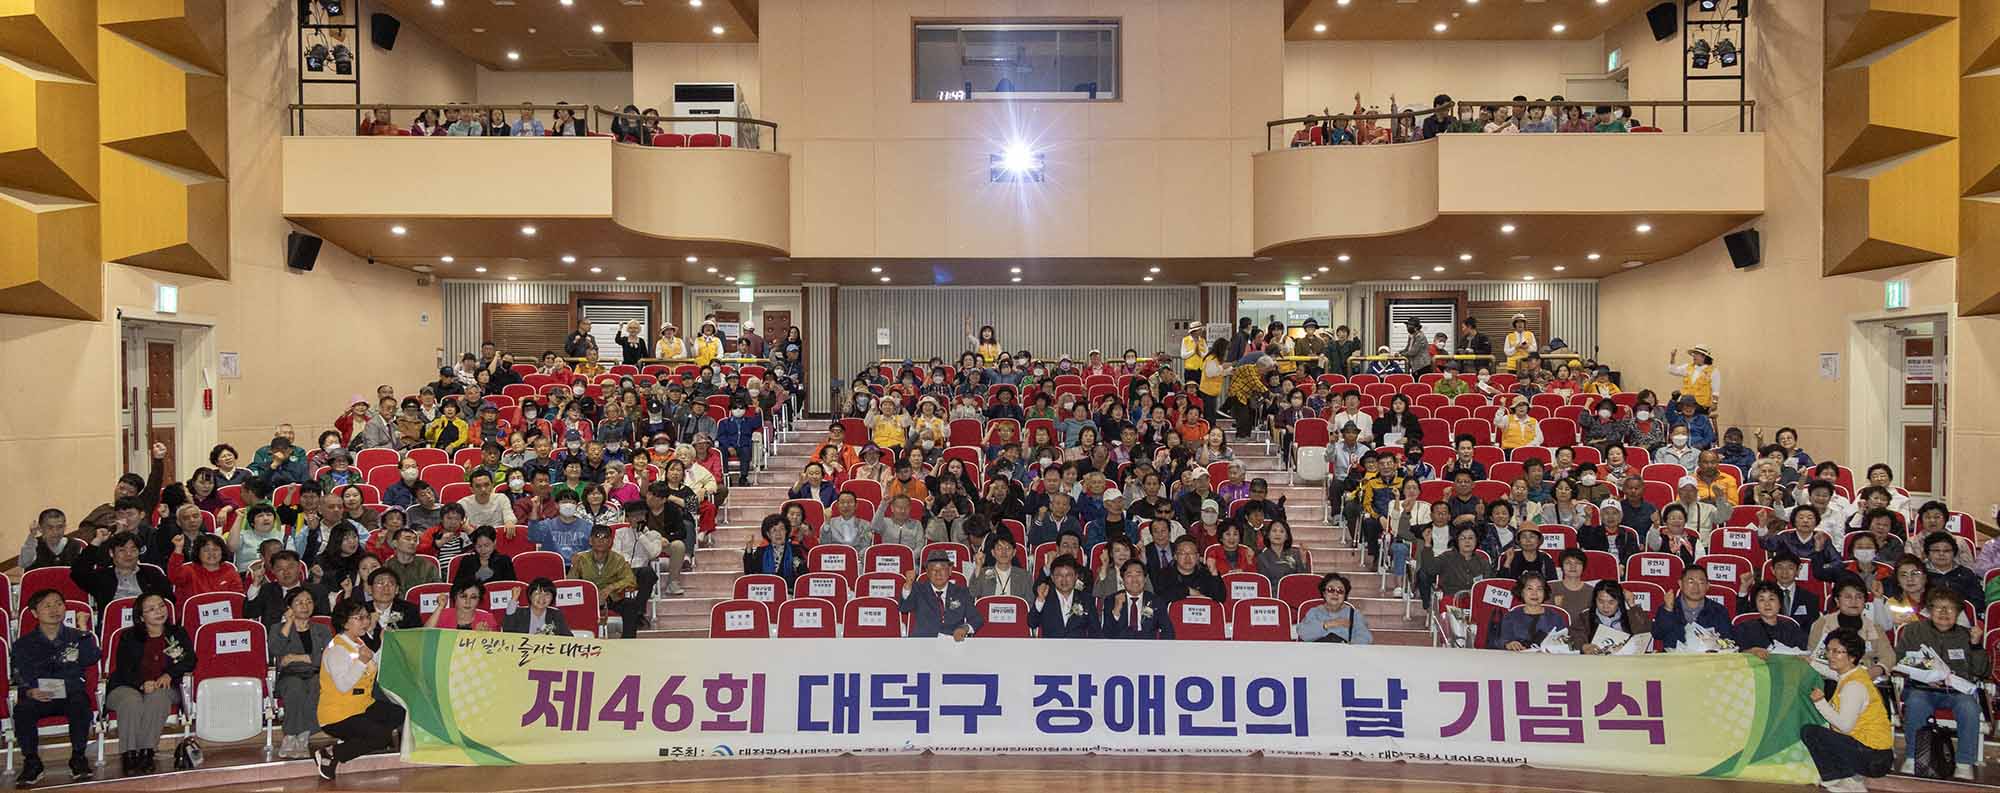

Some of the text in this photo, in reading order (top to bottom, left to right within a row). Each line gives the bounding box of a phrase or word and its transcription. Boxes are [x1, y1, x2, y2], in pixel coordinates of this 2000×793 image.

[458, 637, 476, 650] 내
[517, 636, 557, 668] 즐거운
[559, 642, 602, 659] 대덕구
[523, 671, 1664, 743] 제46회 대덕구 장애인의 날 기념식
